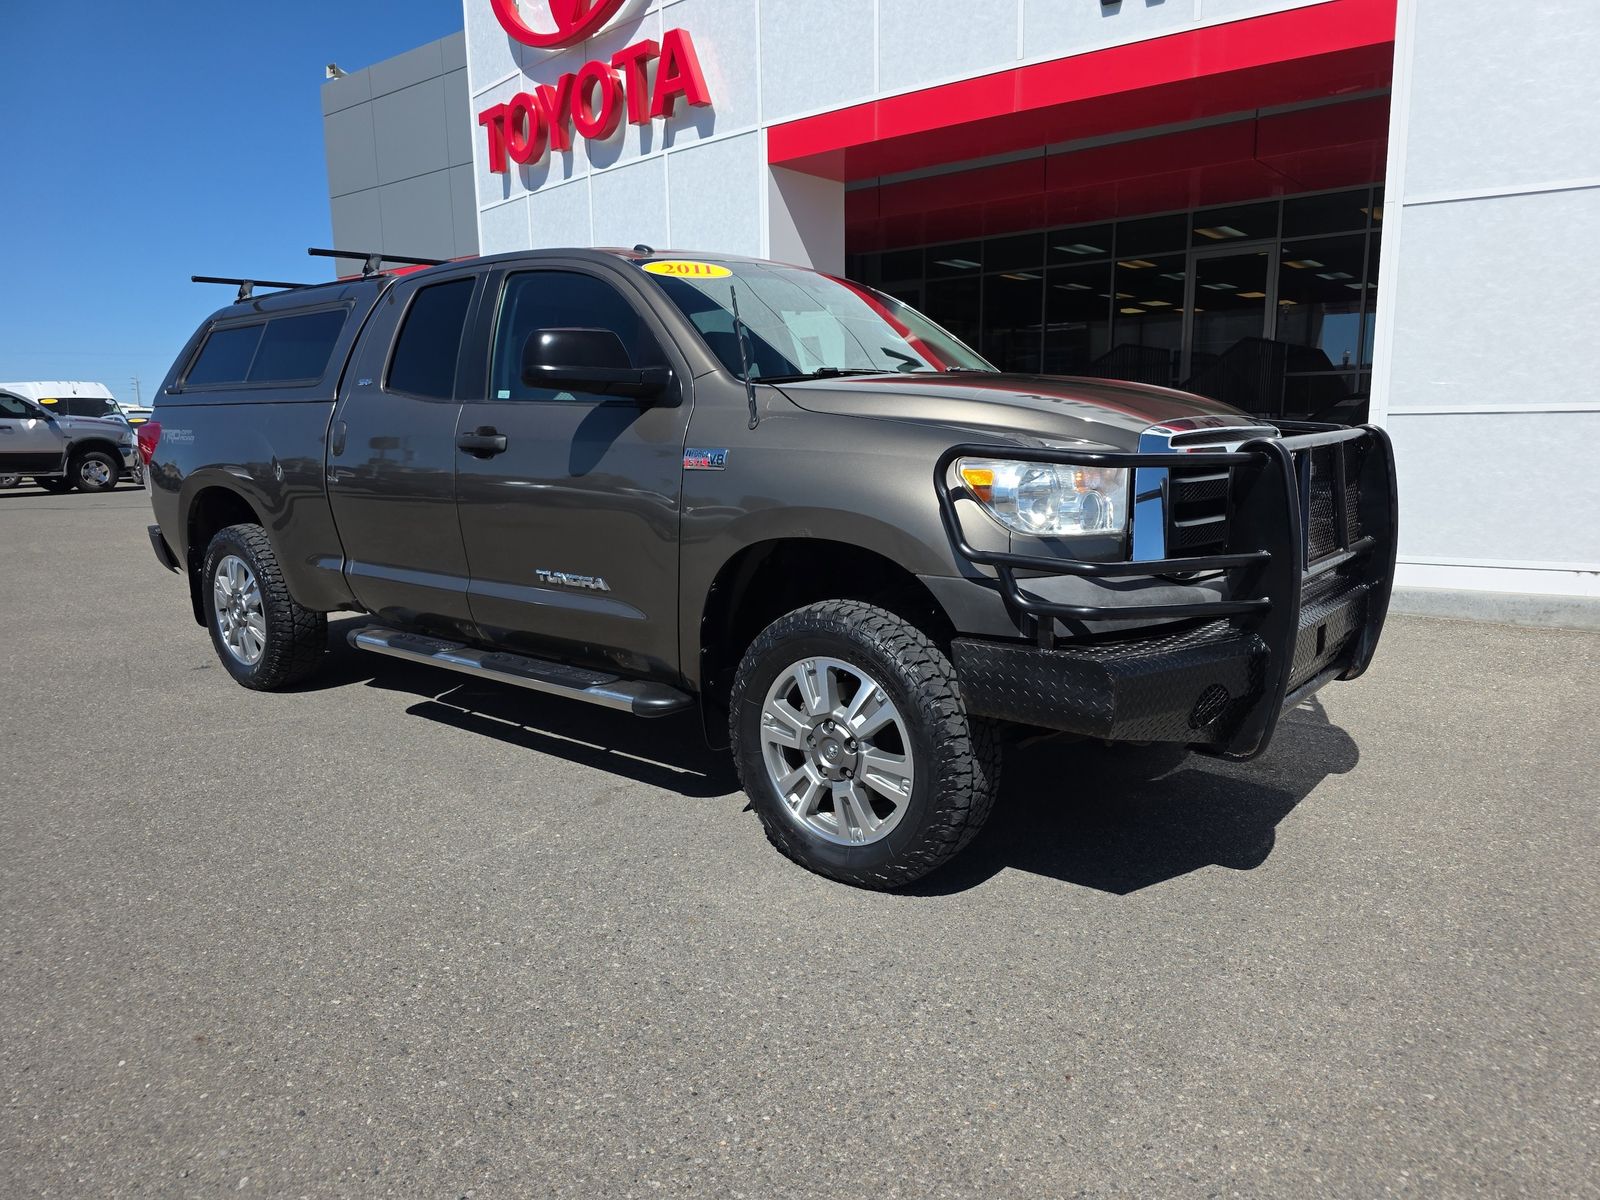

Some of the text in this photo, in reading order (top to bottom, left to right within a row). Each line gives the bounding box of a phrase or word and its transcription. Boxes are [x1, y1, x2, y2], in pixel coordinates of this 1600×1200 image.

[478, 28, 712, 174] TOYOTA
[662, 263, 712, 275] 2011
[709, 453, 725, 466] V8
[535, 568, 612, 592] TUNDRA
